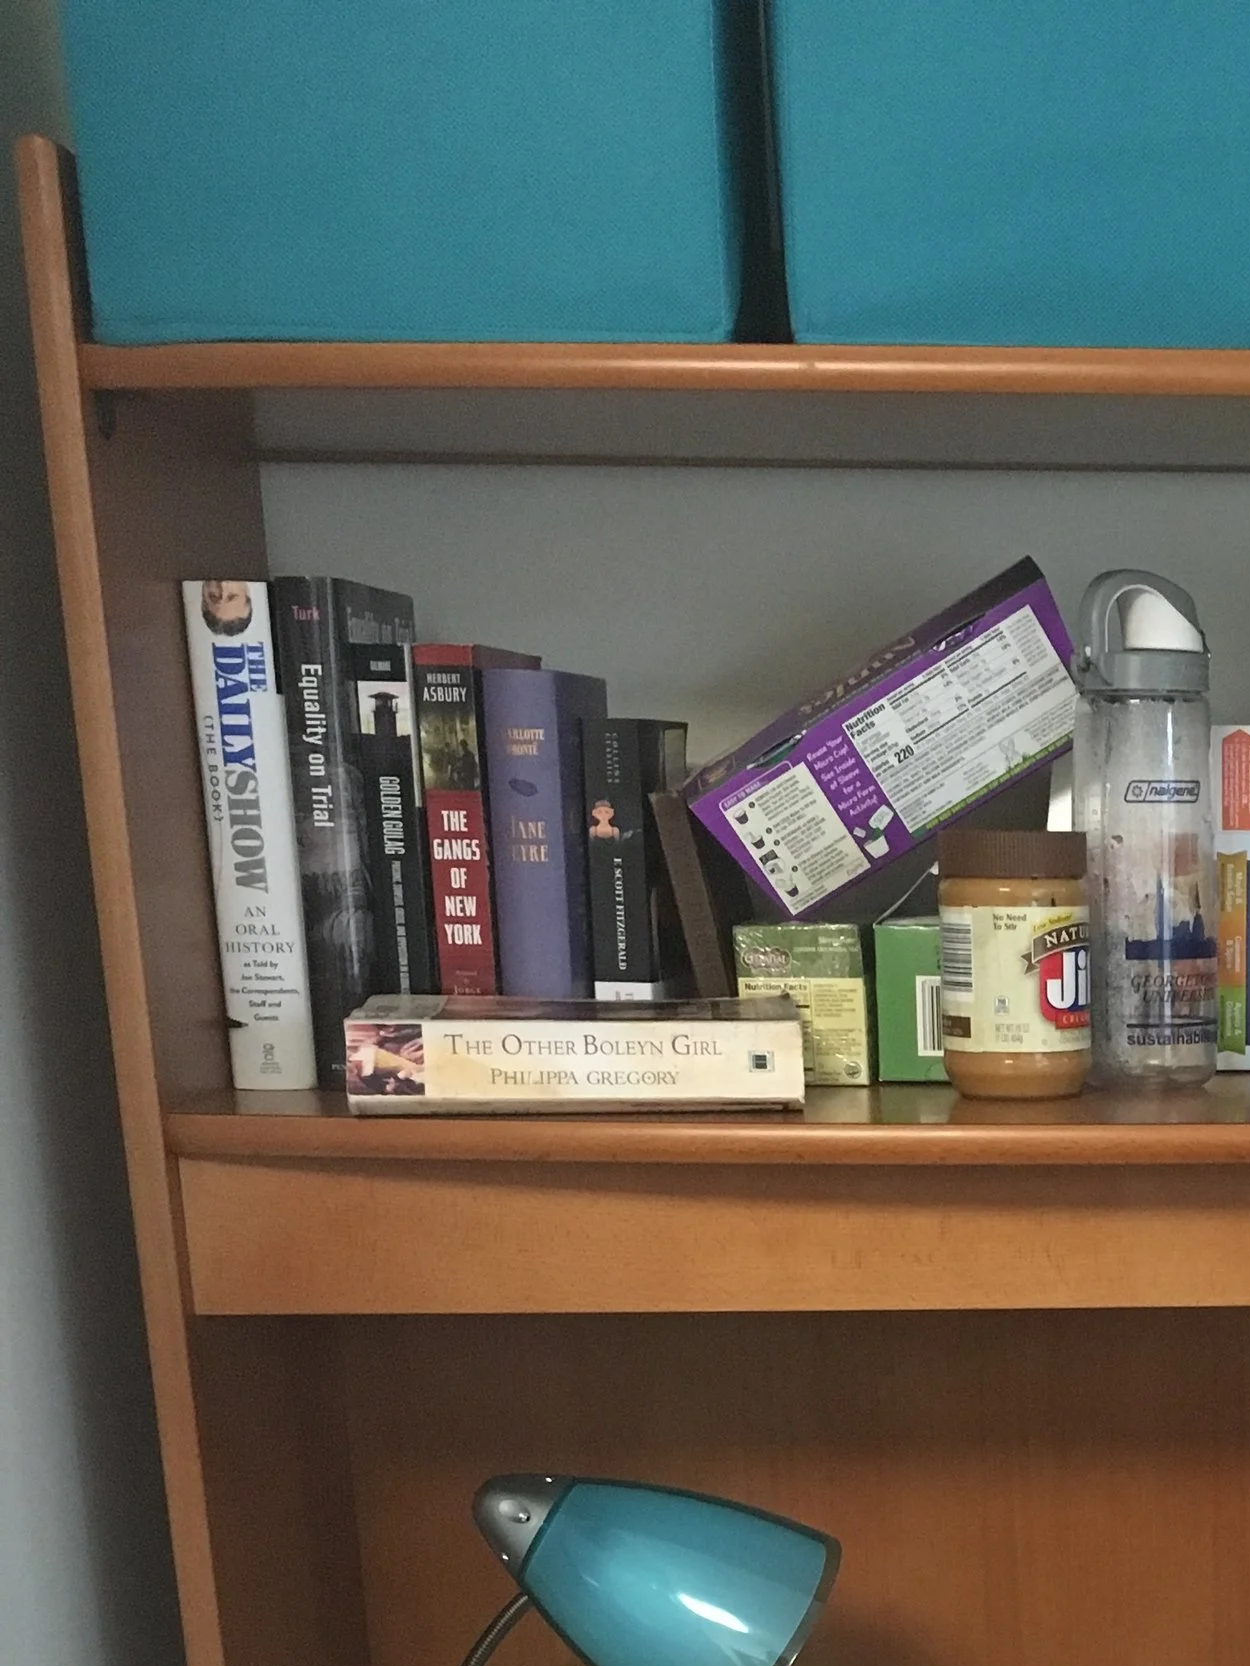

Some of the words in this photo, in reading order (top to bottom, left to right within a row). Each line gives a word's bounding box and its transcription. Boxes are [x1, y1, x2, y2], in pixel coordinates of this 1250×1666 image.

[292, 605, 320, 621] Turk
[246, 641, 268, 692] THE
[427, 673, 460, 684] HERBERT
[298, 663, 327, 745] Equality
[423, 687, 467, 702] ASBURY
[211, 642, 256, 773] DAILY
[844, 703, 886, 732] Nutrition
[850, 720, 876, 739] Facts
[309, 753, 325, 776] on
[894, 744, 915, 764] 220
[379, 776, 403, 819] GOLDEN
[1149, 783, 1199, 799] nalgene
[311, 785, 335, 828] Trial
[224, 769, 269, 894] SHOW
[441, 810, 469, 832] THE
[382, 820, 406, 855] GULAG
[433, 839, 481, 862] GANGS
[450, 867, 469, 889] OF
[614, 867, 624, 904] SCOTT
[244, 906, 267, 917] AN
[444, 895, 477, 918] NEW
[992, 914, 1004, 922] No
[1006, 913, 1027, 922] Need
[235, 924, 280, 935] ORAL
[444, 923, 483, 945] YORK
[1004, 922, 1018, 930] Stir
[1044, 926, 1089, 948] NATU
[225, 942, 296, 953] HISTORY
[616, 905, 627, 970] FITZGERALD
[253, 960, 268, 968] Told
[269, 960, 278, 970] by
[745, 983, 782, 991] Nutrition
[783, 983, 807, 991] Facts
[1046, 949, 1091, 1009] Ji
[444, 1033, 492, 1056] THE
[501, 1033, 577, 1056] OTHER
[583, 1033, 664, 1056] BOLEYN
[671, 1033, 722, 1057] GIRL
[586, 1069, 679, 1087] GREGORY
